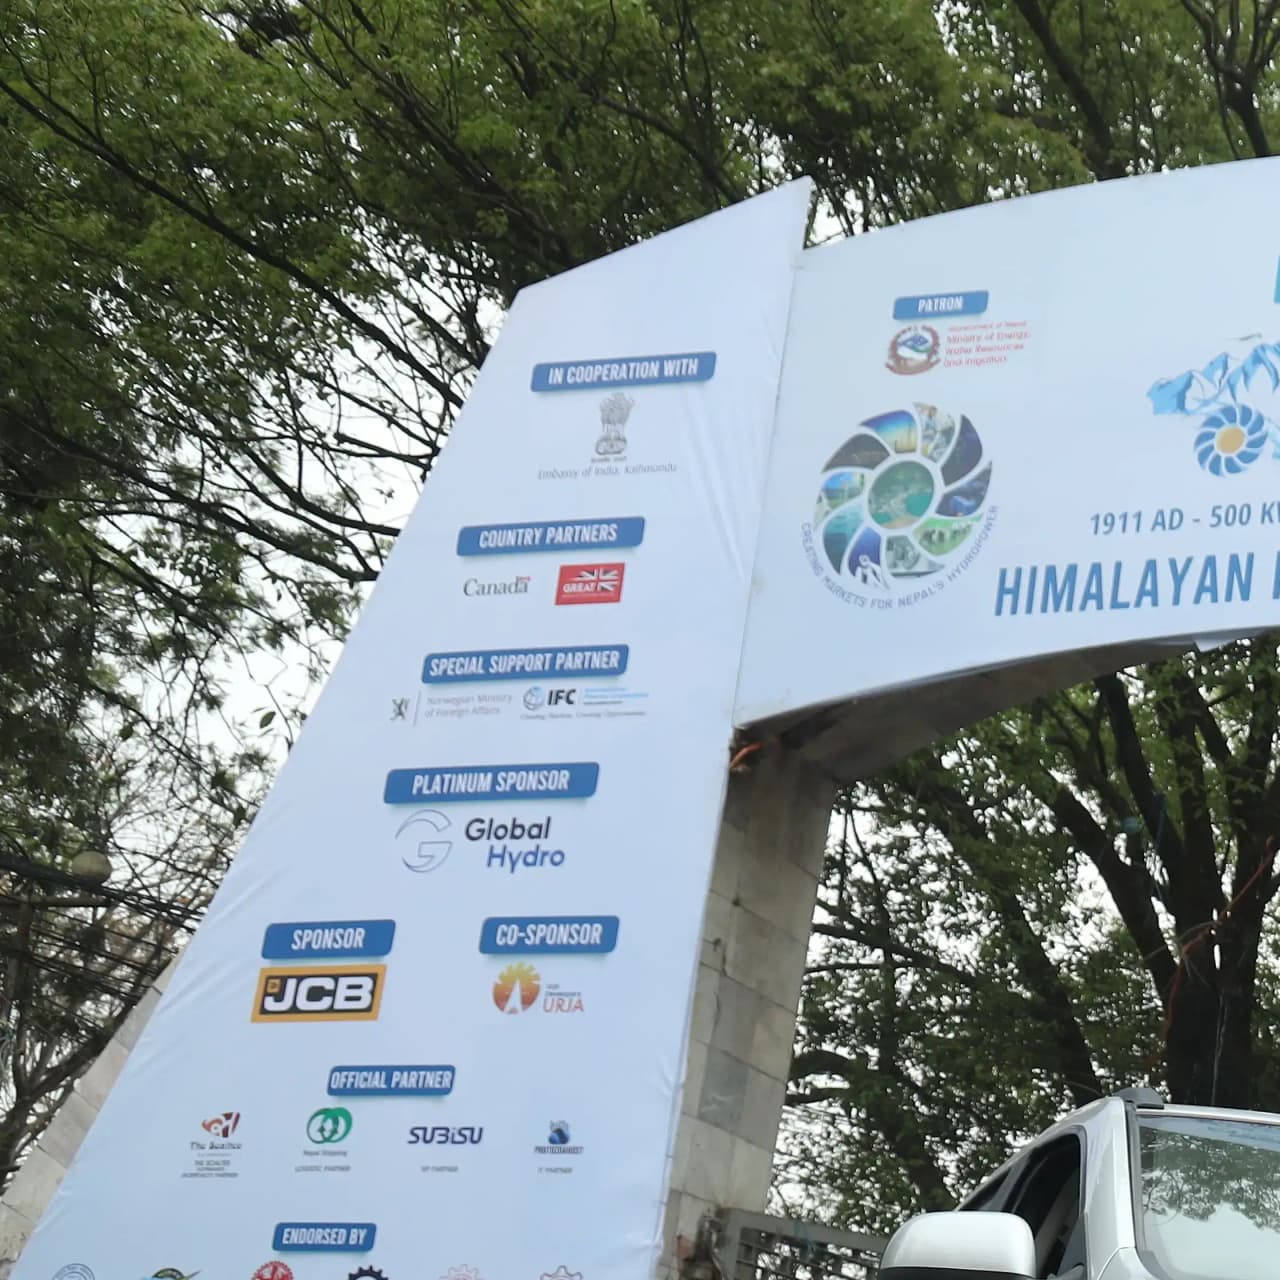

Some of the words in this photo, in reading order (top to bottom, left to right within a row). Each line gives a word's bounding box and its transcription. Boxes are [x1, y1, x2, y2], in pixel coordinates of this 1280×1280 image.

[918, 295, 964, 313] PATRON
[549, 368, 563, 384] IN
[567, 361, 660, 384] COOPERATION
[664, 358, 698, 376] WITH
[1090, 511, 1142, 535] 1911
[1151, 508, 1184, 531] AD
[1209, 504, 1251, 528] 500
[479, 528, 543, 548] COUNTRY
[546, 524, 618, 544] PARTNERS
[464, 576, 529, 597] Canada
[563, 584, 594, 593] GREAT
[995, 552, 1254, 616] HIMALAYAN
[870, 596, 893, 609] FOR
[430, 658, 485, 676] SPECIAL
[489, 653, 552, 673] SUPPORT
[556, 651, 619, 670] PARTNER
[548, 689, 576, 705] IFC
[412, 773, 491, 795] PLATINUM
[495, 770, 570, 792] SPONSOR
[465, 817, 551, 841] Global
[486, 844, 565, 873] Hydro
[291, 928, 365, 950] SPONSOR
[496, 923, 602, 945] CO-SPONSOR
[264, 976, 374, 1011] JCB
[543, 998, 584, 1013] URJA
[331, 1071, 387, 1089] OFFICIAL
[391, 1071, 452, 1088] PARTNER
[282, 1228, 346, 1245] ENDORSED
[349, 1228, 367, 1245] BY
